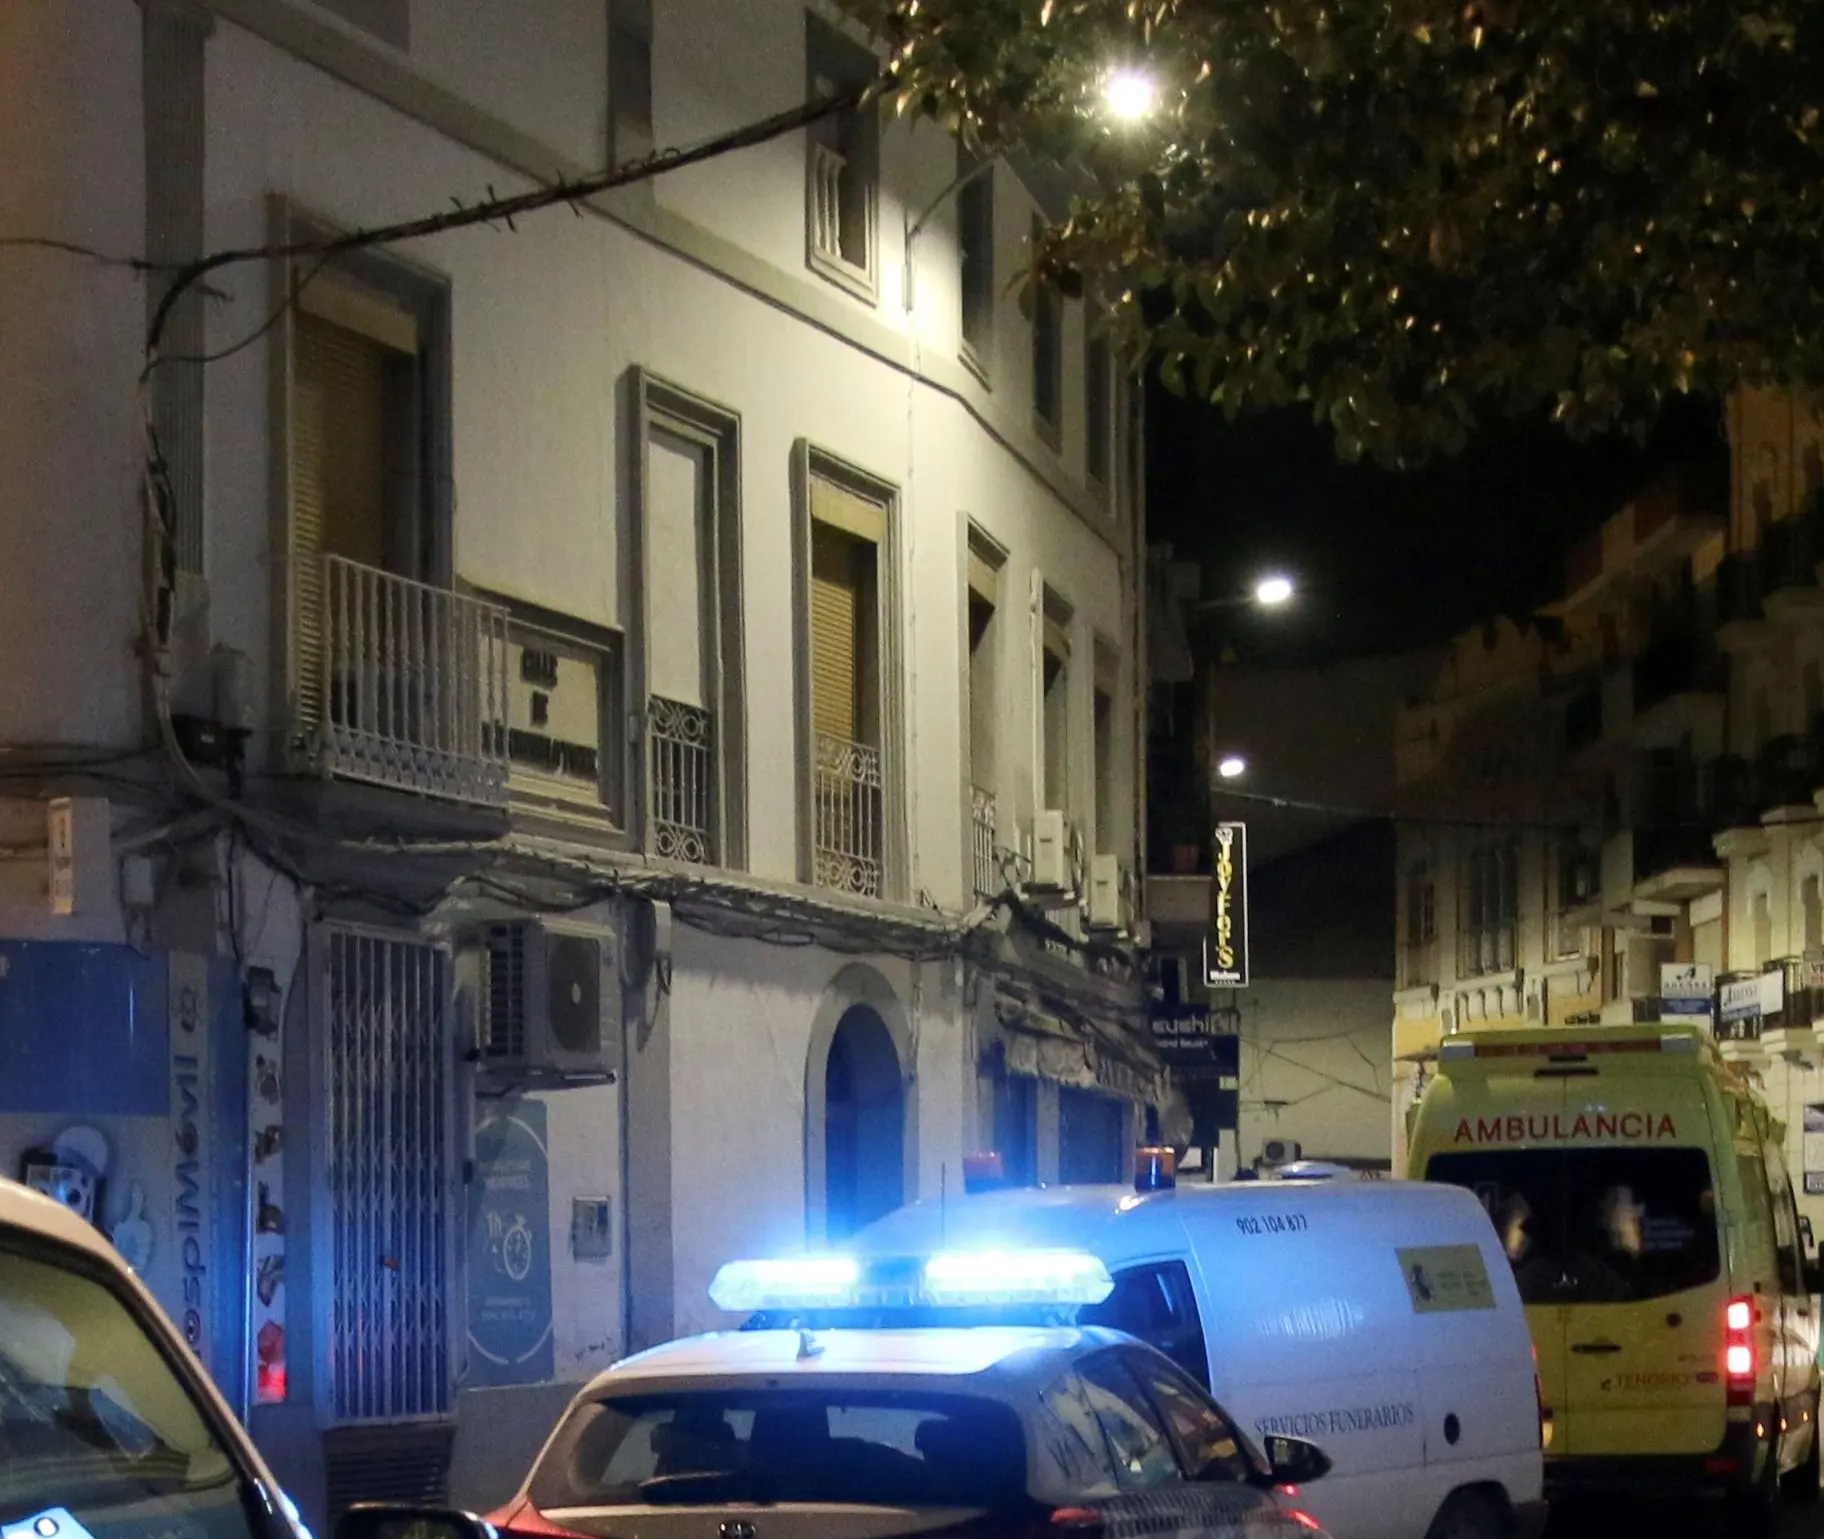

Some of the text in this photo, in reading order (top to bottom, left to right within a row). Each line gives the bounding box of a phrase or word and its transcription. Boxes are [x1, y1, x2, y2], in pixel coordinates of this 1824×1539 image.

[1454, 1112, 1677, 1143] AMBULANCIA
[1236, 1216, 1262, 1235] 902
[1254, 1402, 1414, 1436] SERVICIOS FUNERARIOS
